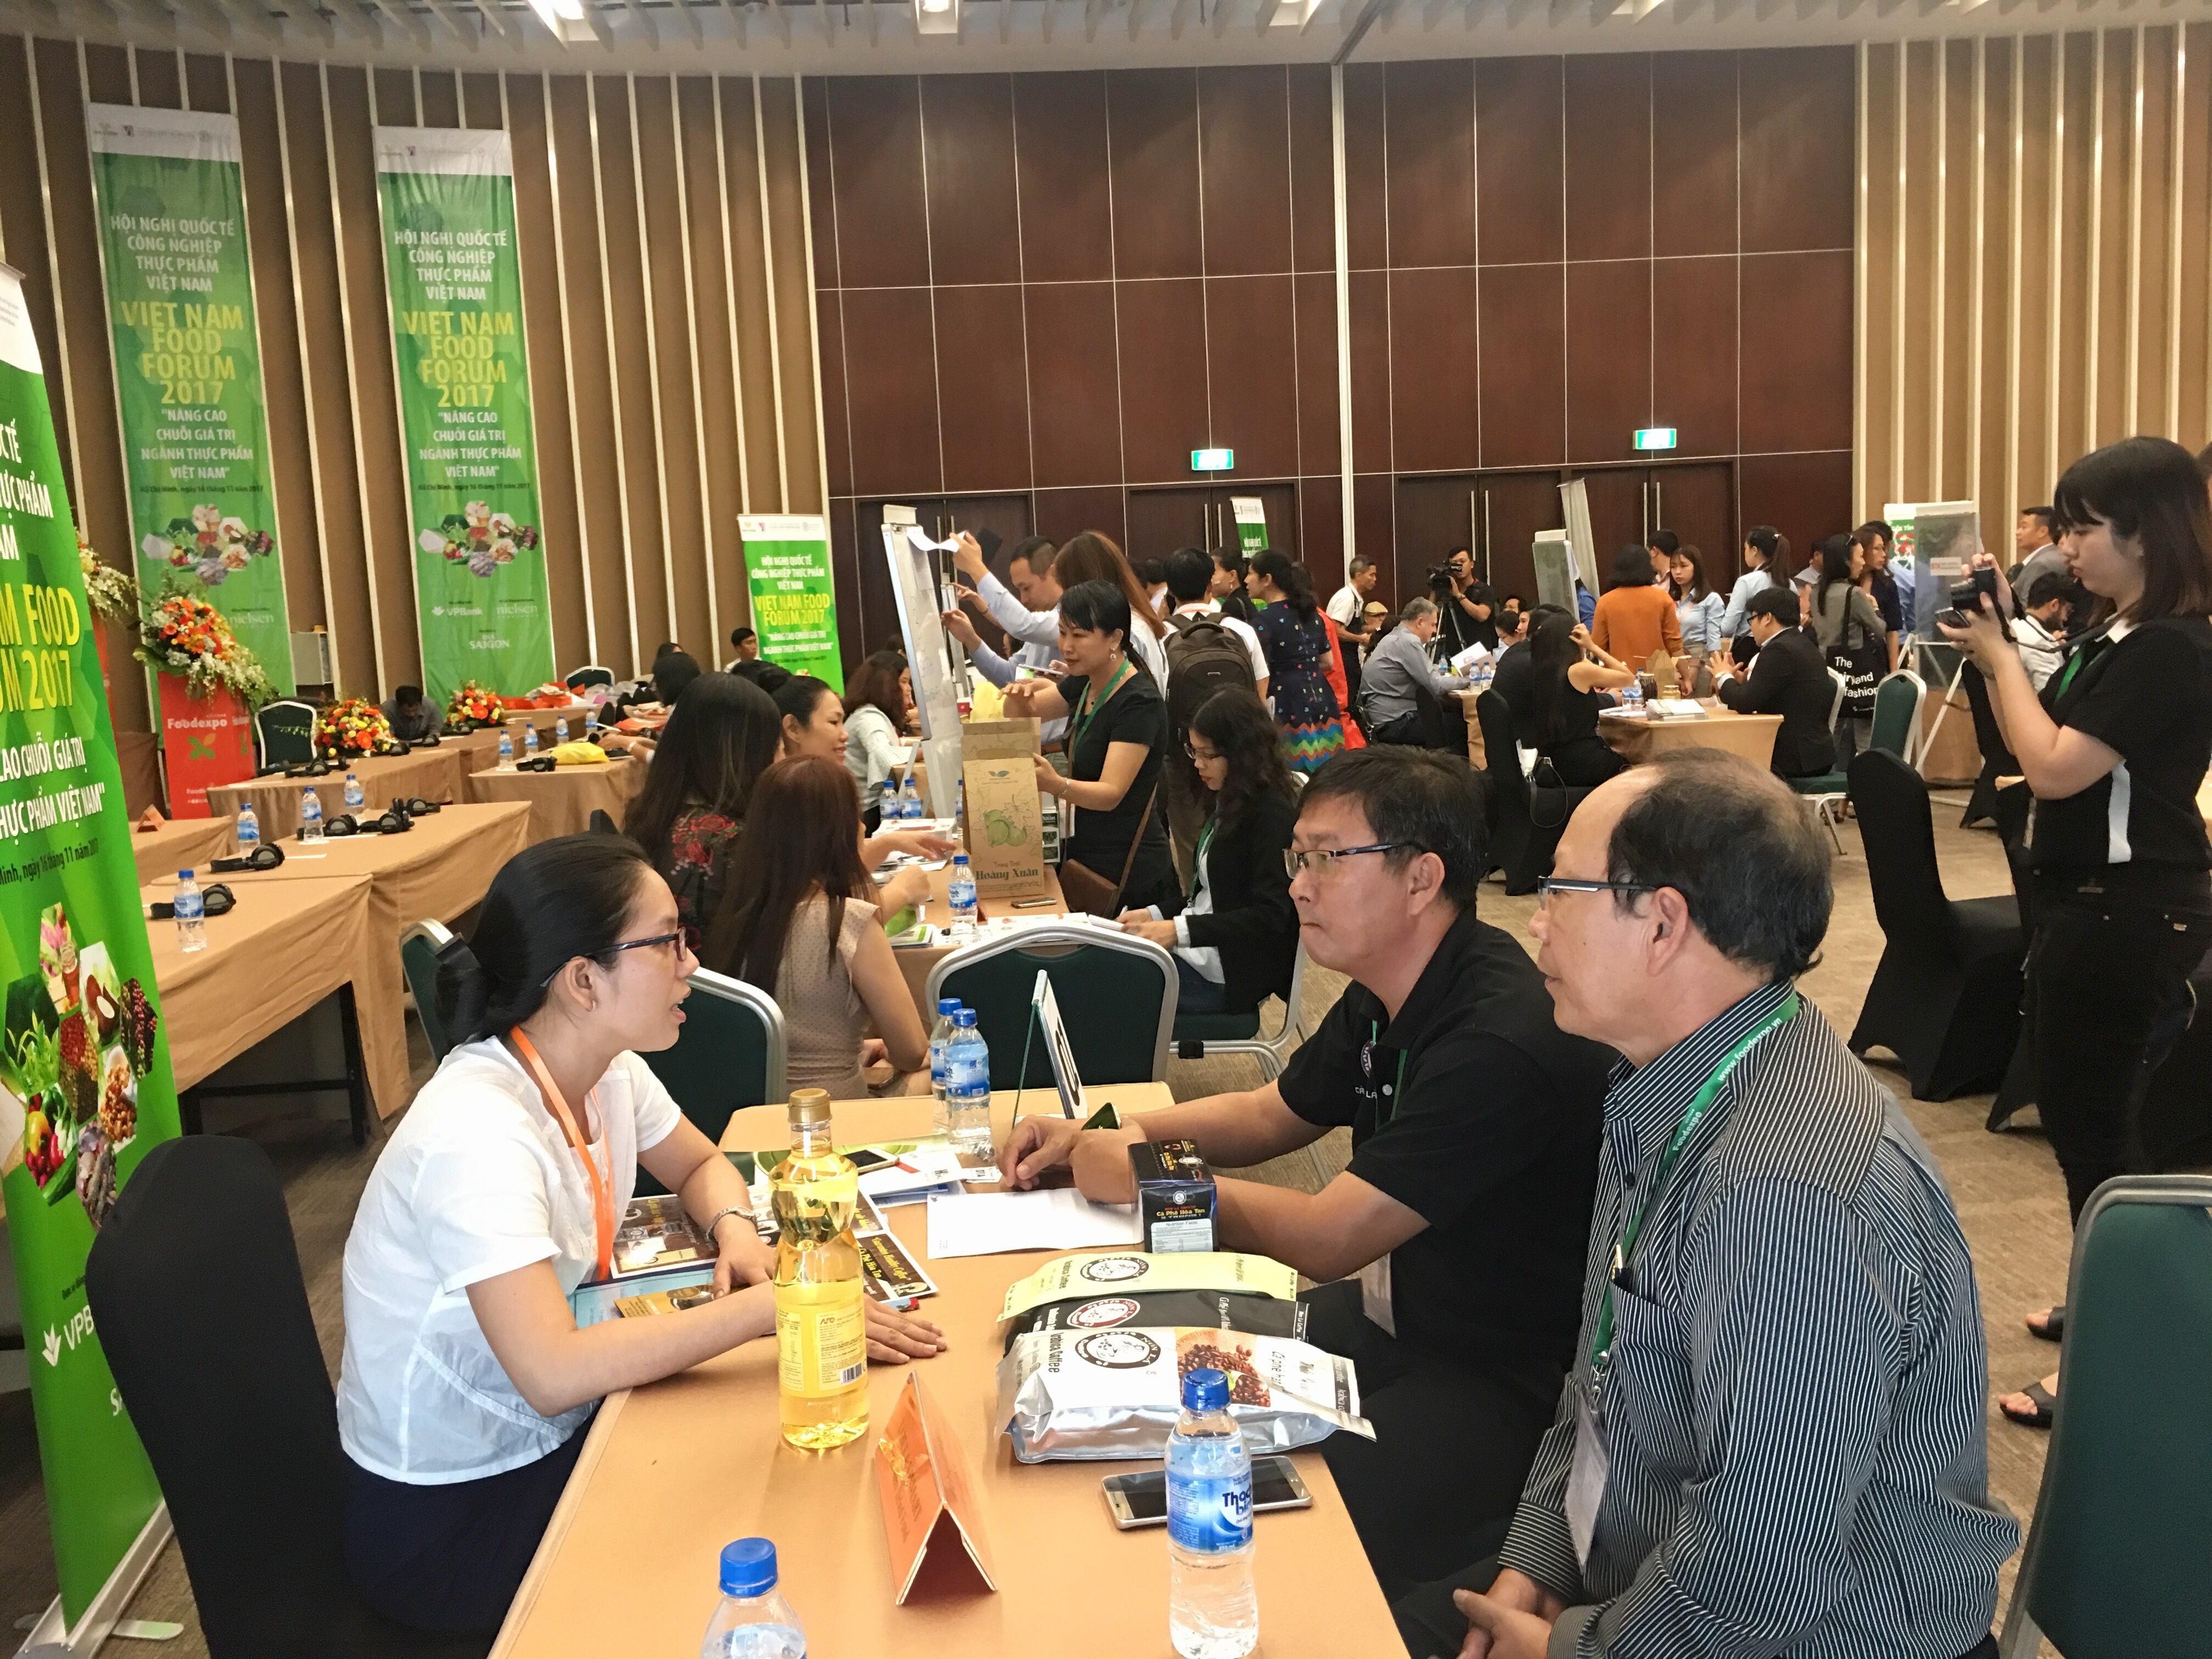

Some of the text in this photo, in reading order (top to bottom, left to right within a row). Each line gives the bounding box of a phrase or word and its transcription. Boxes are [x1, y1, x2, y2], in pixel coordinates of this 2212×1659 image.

[111, 215, 235, 236] HỘI NGHỊ QUỐC TẾ
[128, 234, 222, 257] CÔNG NGHIỆP
[395, 229, 507, 248] HỘI NGHỊ QUỐC TẾ
[136, 254, 219, 275] THỰC PHẨM
[409, 247, 495, 267] CÔNG NGHIỆP
[146, 274, 213, 294] VIỆT NAM
[416, 266, 492, 285] THỰC PHẨM
[426, 285, 486, 303] VIỆT NAM
[121, 301, 243, 330] VIET NAM
[403, 311, 515, 336] VIET NAM
[152, 329, 222, 354] FOOD
[431, 335, 494, 359] FOOD
[142, 353, 235, 380] FORUM
[419, 359, 507, 383] FORUM
[161, 381, 224, 404] 2017
[437, 385, 494, 408] 2017
[204, 409, 227, 422] CAO
[477, 412, 498, 423] CAO
[5, 418, 21, 463] TẾ
[195, 427, 213, 441] GIÁ
[217, 428, 235, 445] TRỊ
[468, 428, 486, 441] GIÁ
[488, 430, 505, 444] TRỊ
[188, 448, 218, 464] THỰC
[221, 444, 253, 460] PHẨM
[461, 448, 489, 462] THỰC
[491, 445, 522, 459] PHẨM
[170, 466, 194, 482] VIỆT
[445, 464, 468, 481] VIỆT
[16, 470, 53, 518] PHẨM
[754, 593, 830, 611] VIET NAM FOOD
[22, 584, 80, 645] FOOD
[763, 609, 824, 626] FORUM 2017
[469, 639, 510, 650] SAIGON
[1834, 656, 1853, 668] The
[21, 650, 72, 710] 2017
[167, 717, 228, 730] Foodexpo
[21, 731, 52, 777] CHUỖI
[53, 733, 74, 770] GIÁ
[71, 737, 87, 773] TRỊ
[27, 786, 57, 832] PHẨM
[56, 784, 82, 828] VIỆT
[81, 782, 105, 816] NAM"
[64, 846, 74, 863] 11
[975, 867, 1039, 881] Hoàng Xuân
[1673, 1111, 1702, 1150] Foodexpo
